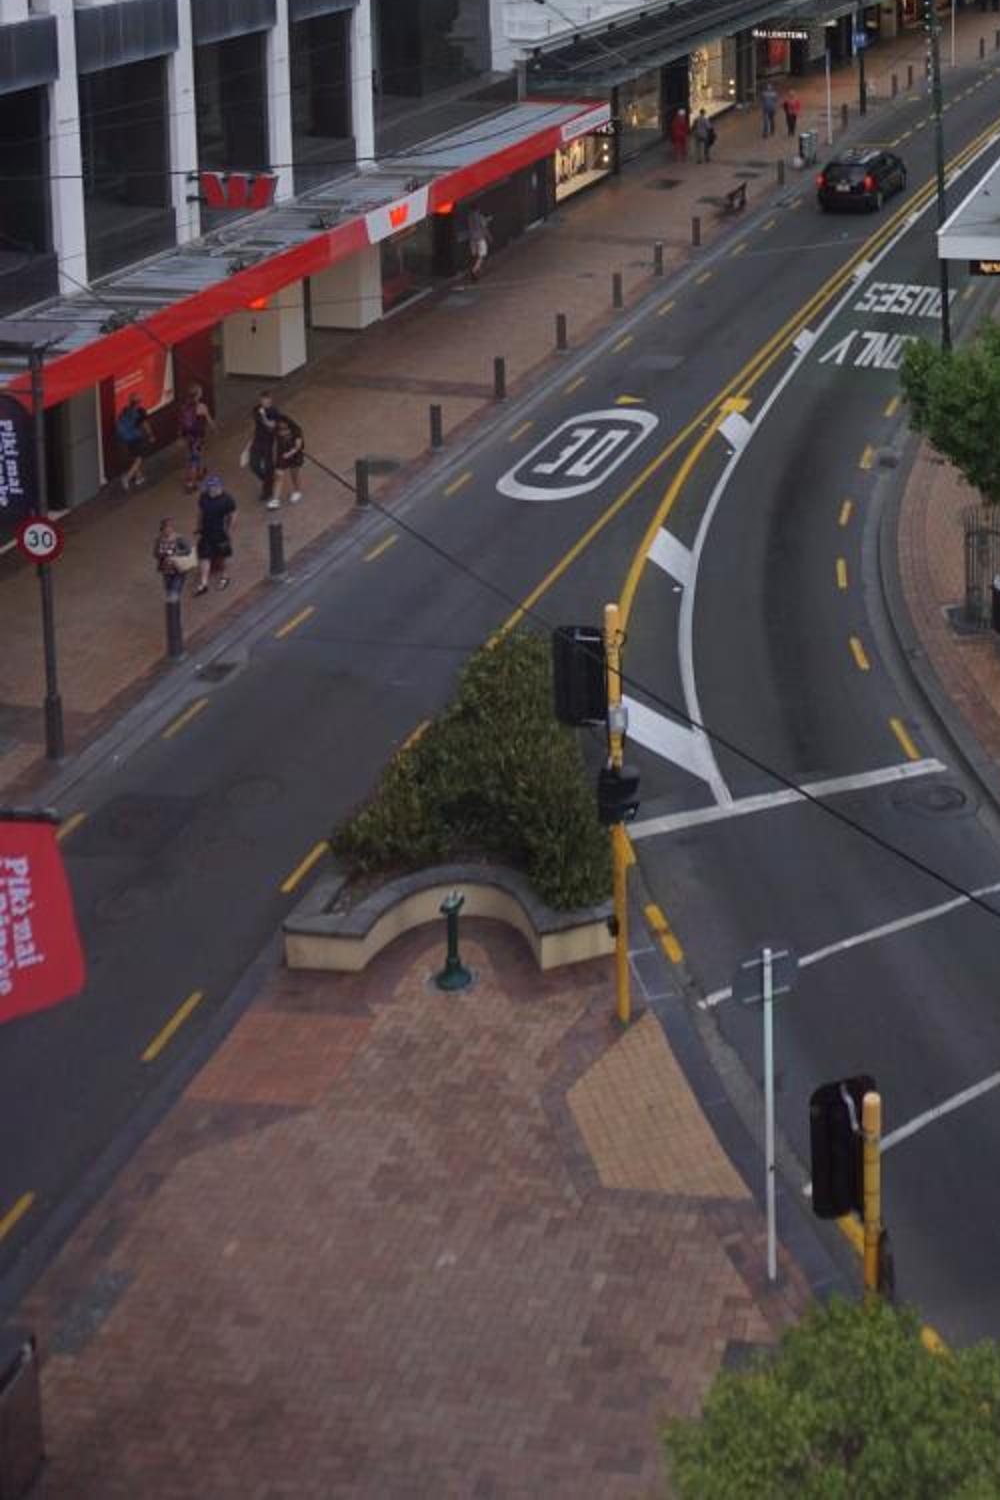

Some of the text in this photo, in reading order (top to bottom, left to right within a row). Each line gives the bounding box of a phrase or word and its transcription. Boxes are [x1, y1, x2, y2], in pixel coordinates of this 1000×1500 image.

[531, 428, 630, 477] 30
[28, 530, 53, 549] 30
[4, 856, 35, 916] Piki
[13, 917, 45, 969] mai
